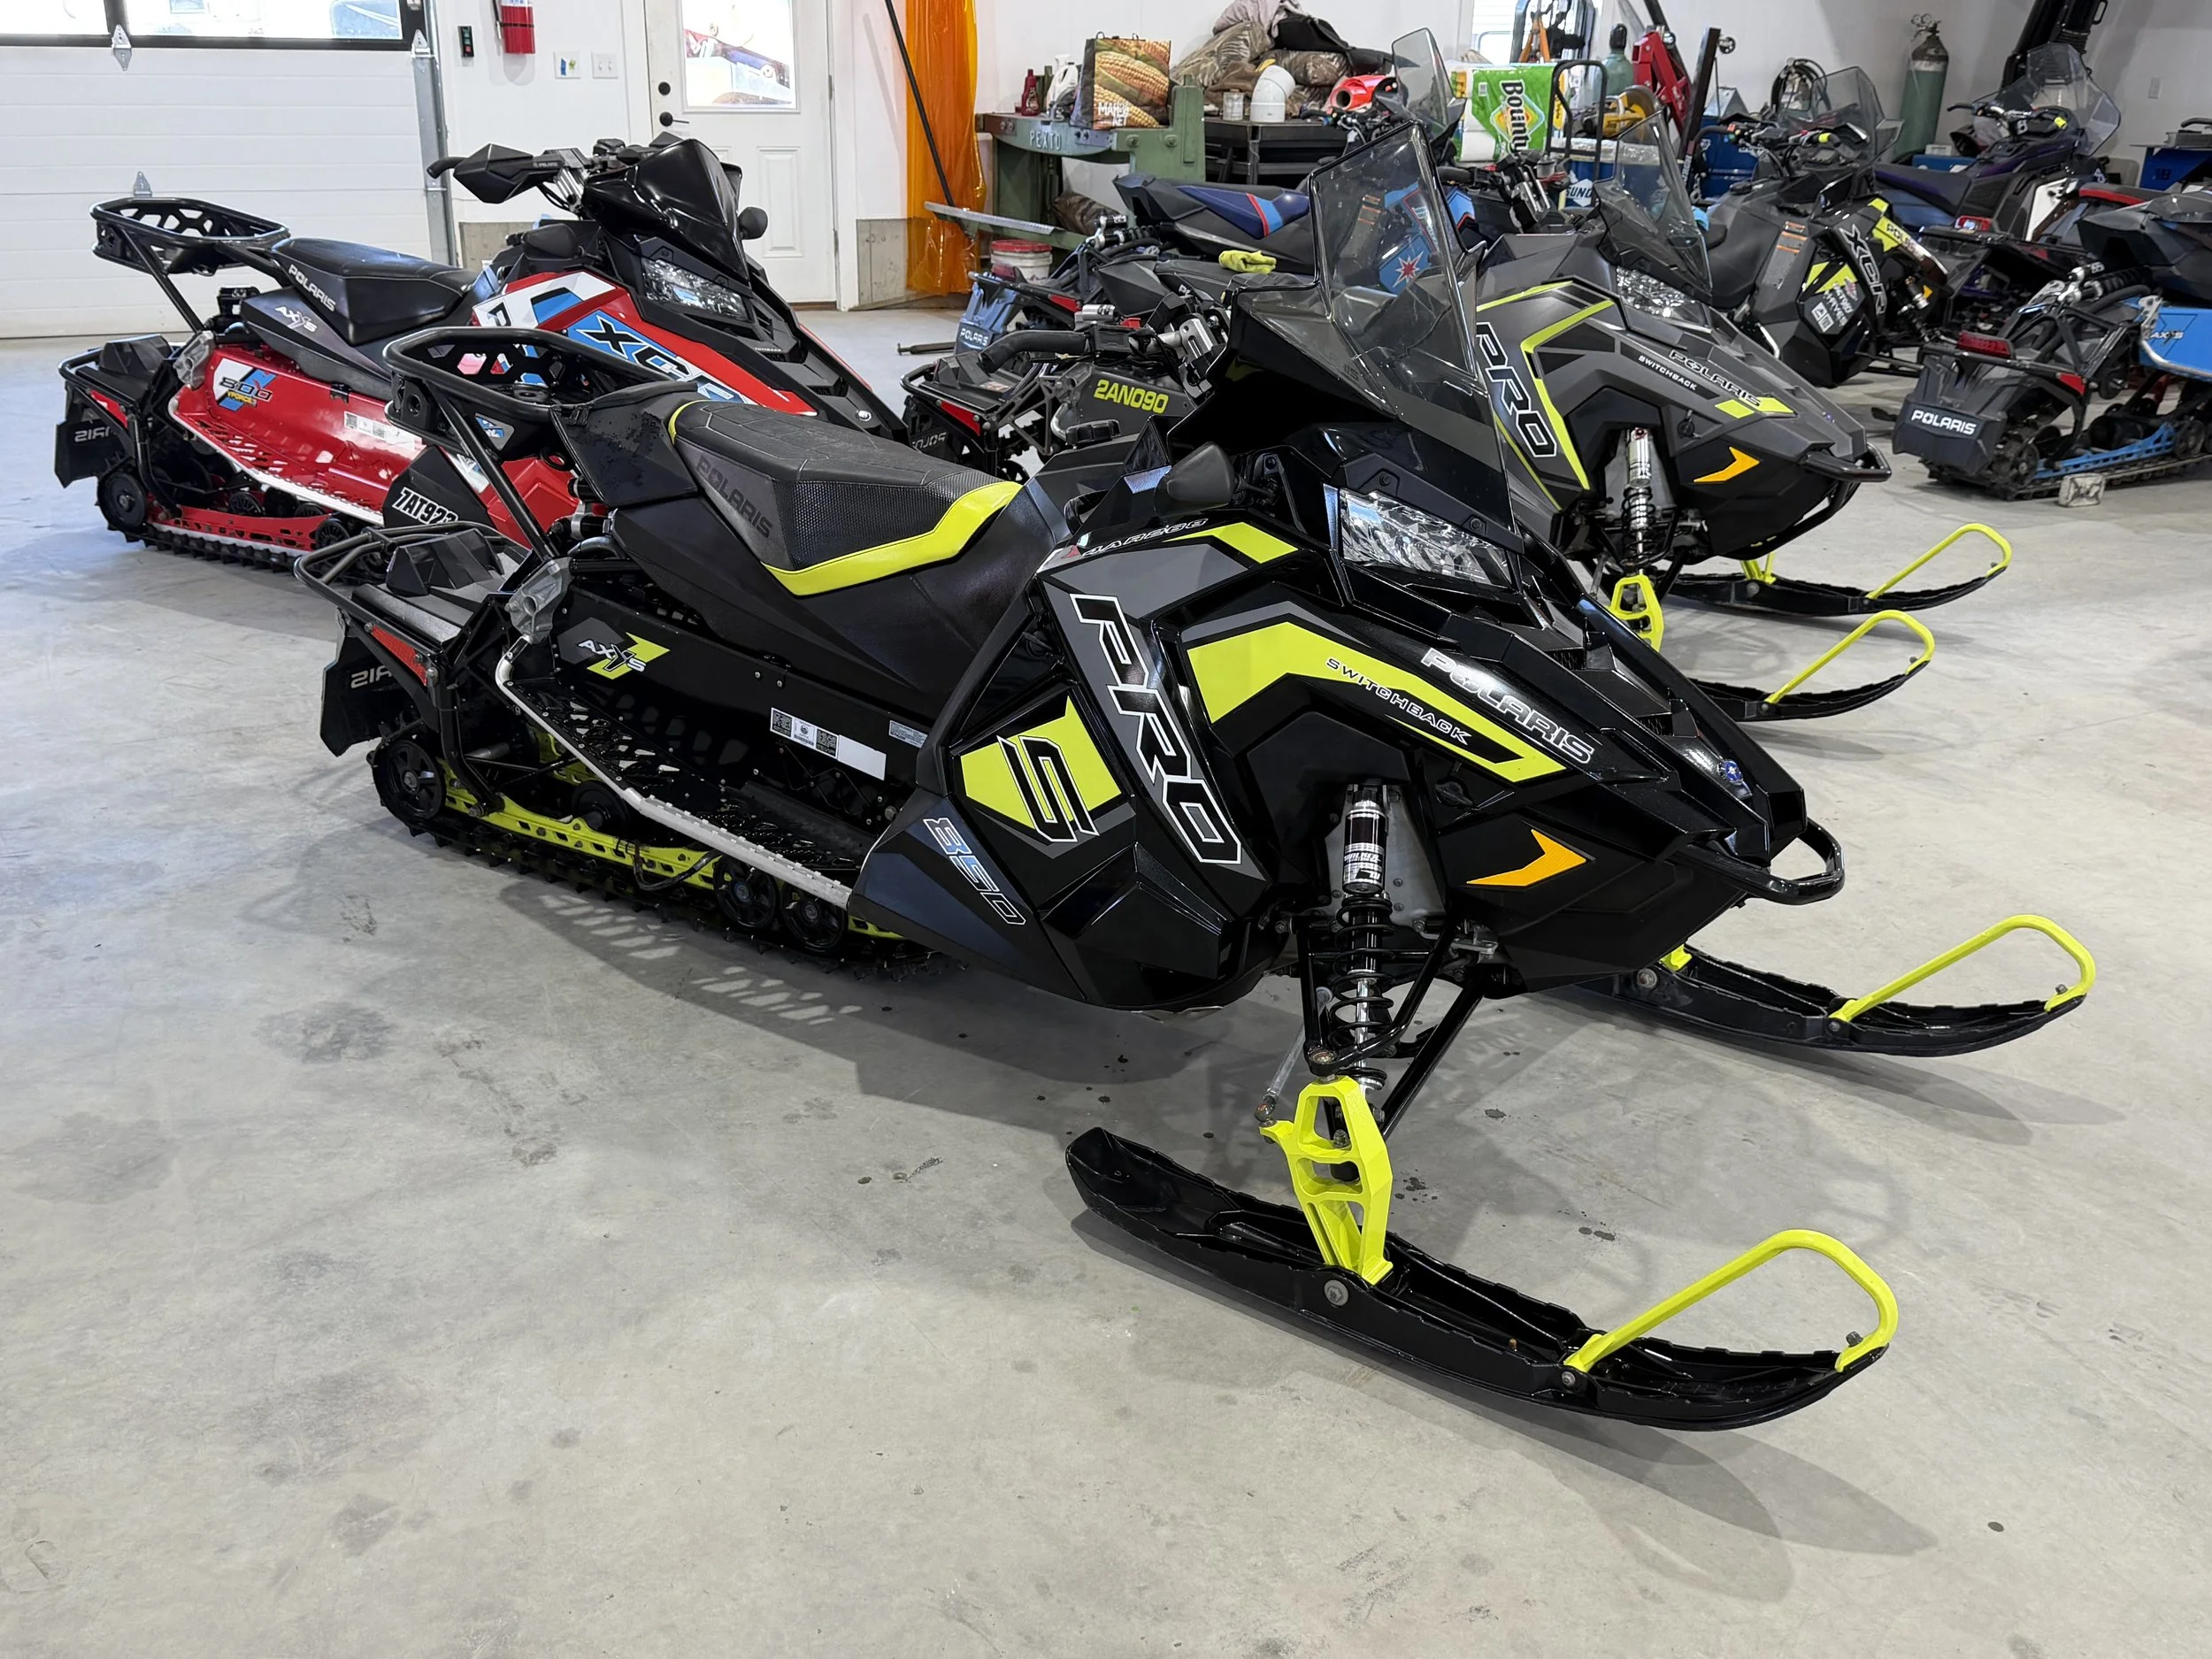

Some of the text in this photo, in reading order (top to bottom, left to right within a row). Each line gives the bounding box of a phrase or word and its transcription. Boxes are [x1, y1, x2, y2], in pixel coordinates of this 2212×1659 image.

[1029, 130, 1061, 150] PEXTO
[288, 264, 336, 311] POLARIS
[219, 376, 273, 403] 800
[1476, 322, 1557, 457] PRO
[1638, 355, 1698, 391] SWITCHBACK
[1669, 349, 1761, 408] POLARIS
[1911, 410, 1977, 435] POLARIS
[696, 455, 773, 538] POLARIS
[1070, 594, 1241, 864] PRO
[1326, 657, 1472, 745] SWITCHBACK
[1420, 647, 1594, 764] POLARIS
[924, 818, 1025, 925] 850
